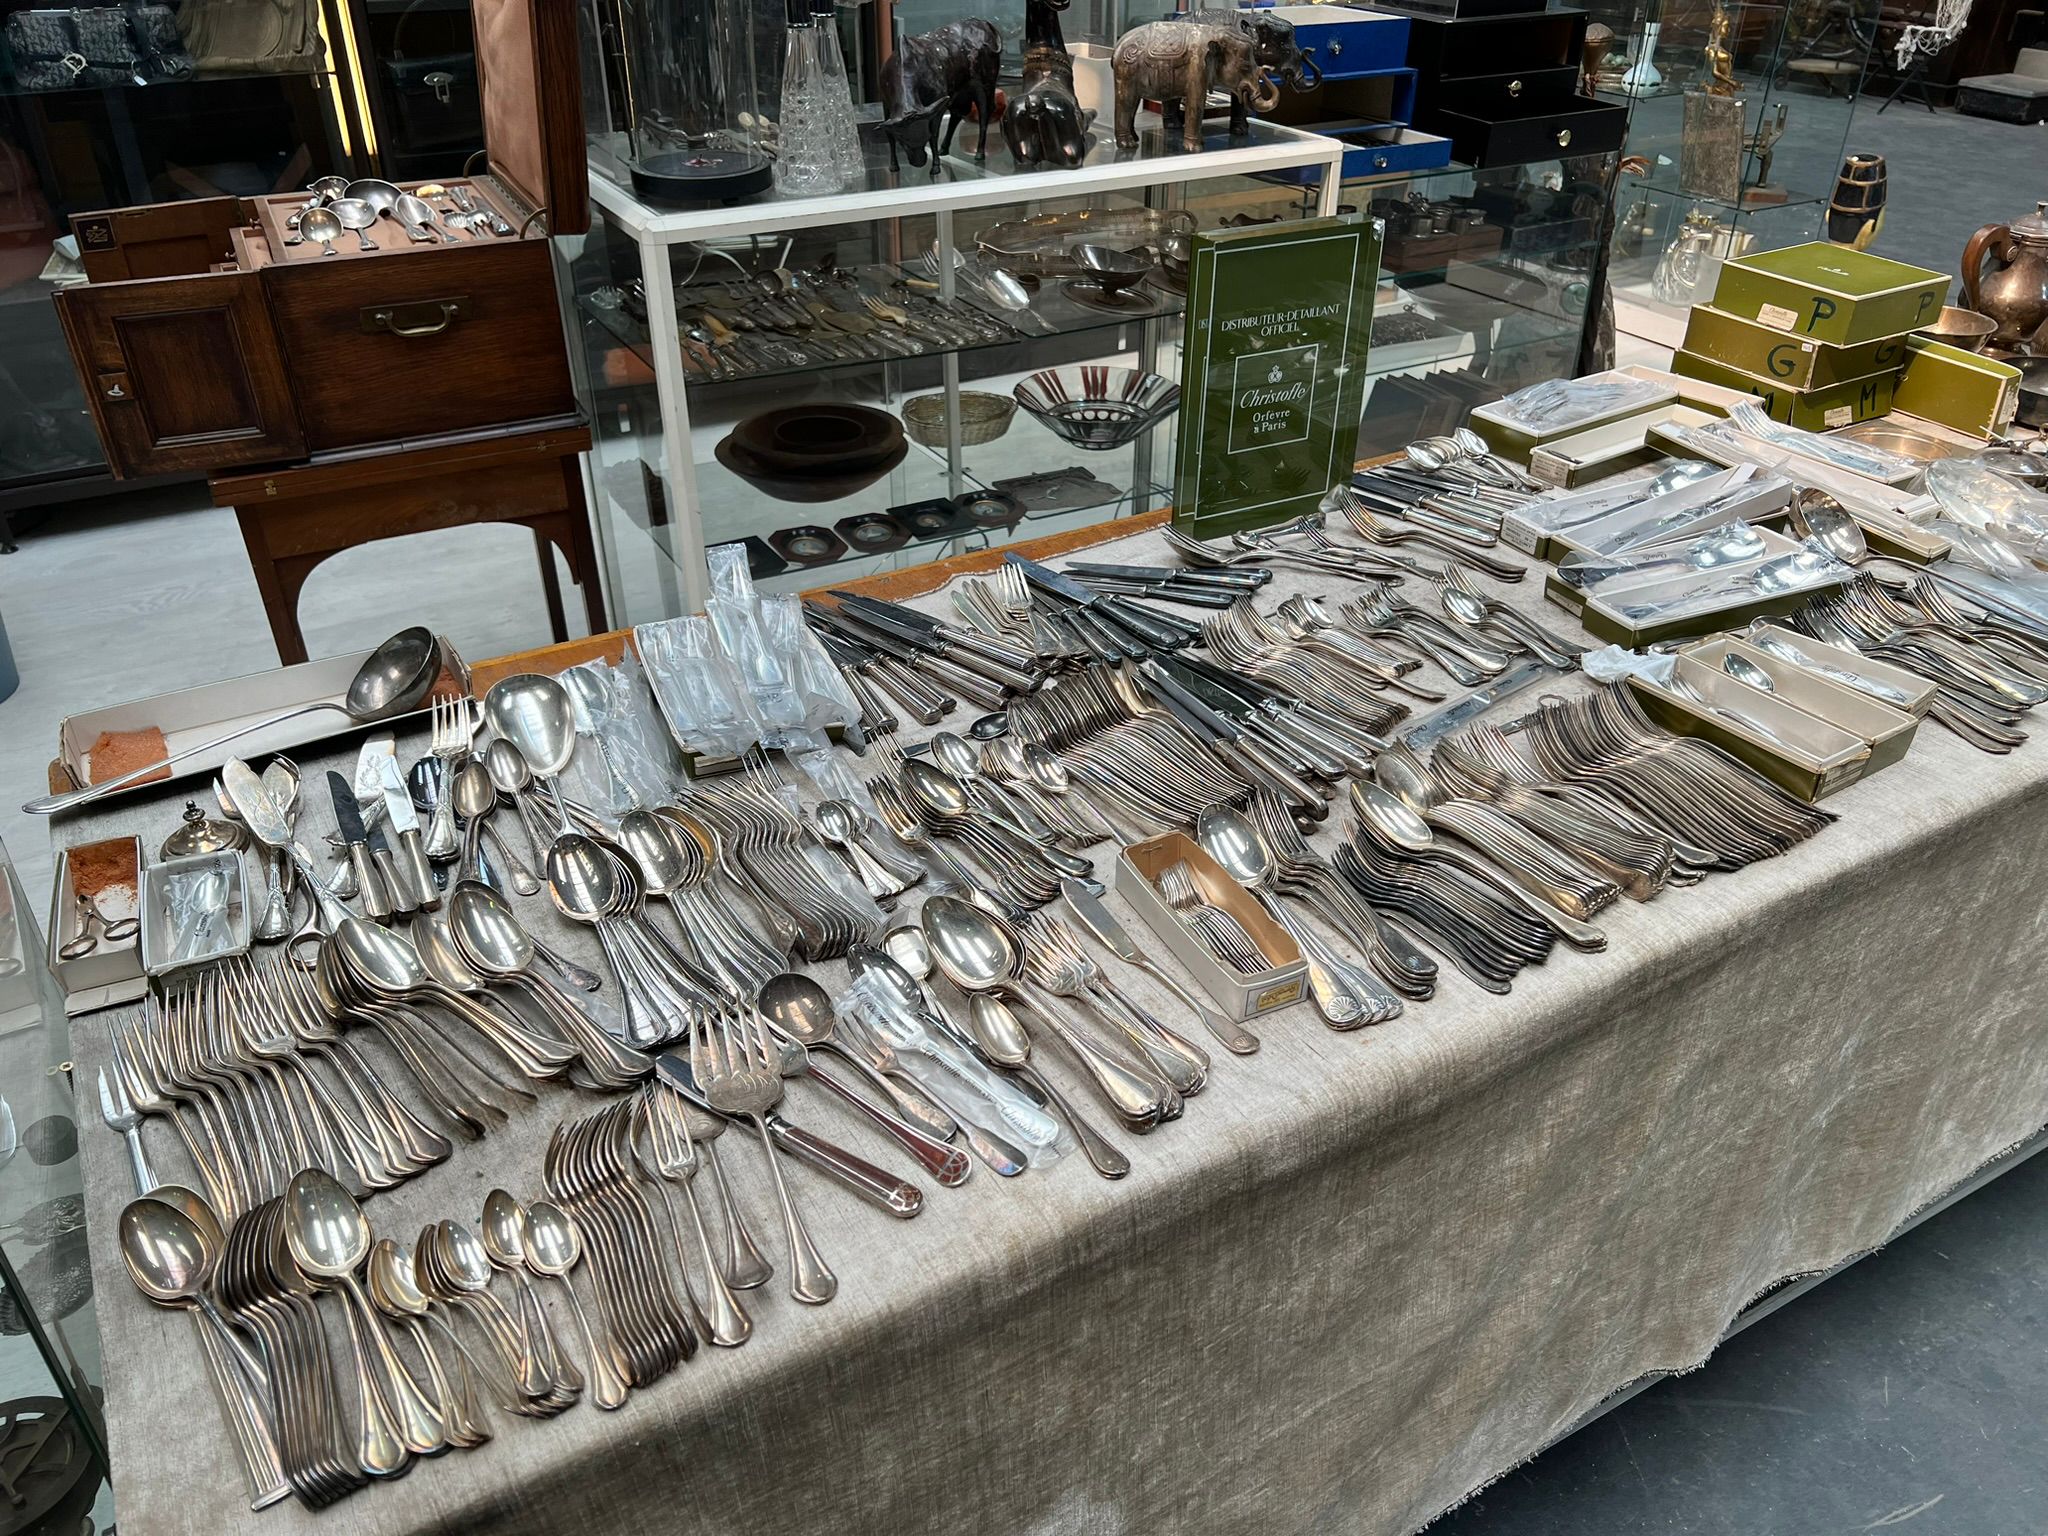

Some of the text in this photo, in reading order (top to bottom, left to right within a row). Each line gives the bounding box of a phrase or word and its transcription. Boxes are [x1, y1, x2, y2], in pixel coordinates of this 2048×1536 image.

[1221, 303, 1341, 332] DISTRIBUTEUR-DETAILLANT
[1808, 296, 1837, 333] P
[1914, 291, 1936, 324] P
[1260, 322, 1299, 337] OFFICIEL
[1767, 344, 1798, 378] G
[1874, 337, 1898, 365] G
[1240, 382, 1306, 409] Christofle
[1860, 382, 1878, 418] M
[1252, 409, 1290, 423] Orfèvre
[1261, 420, 1287, 433] Paris
